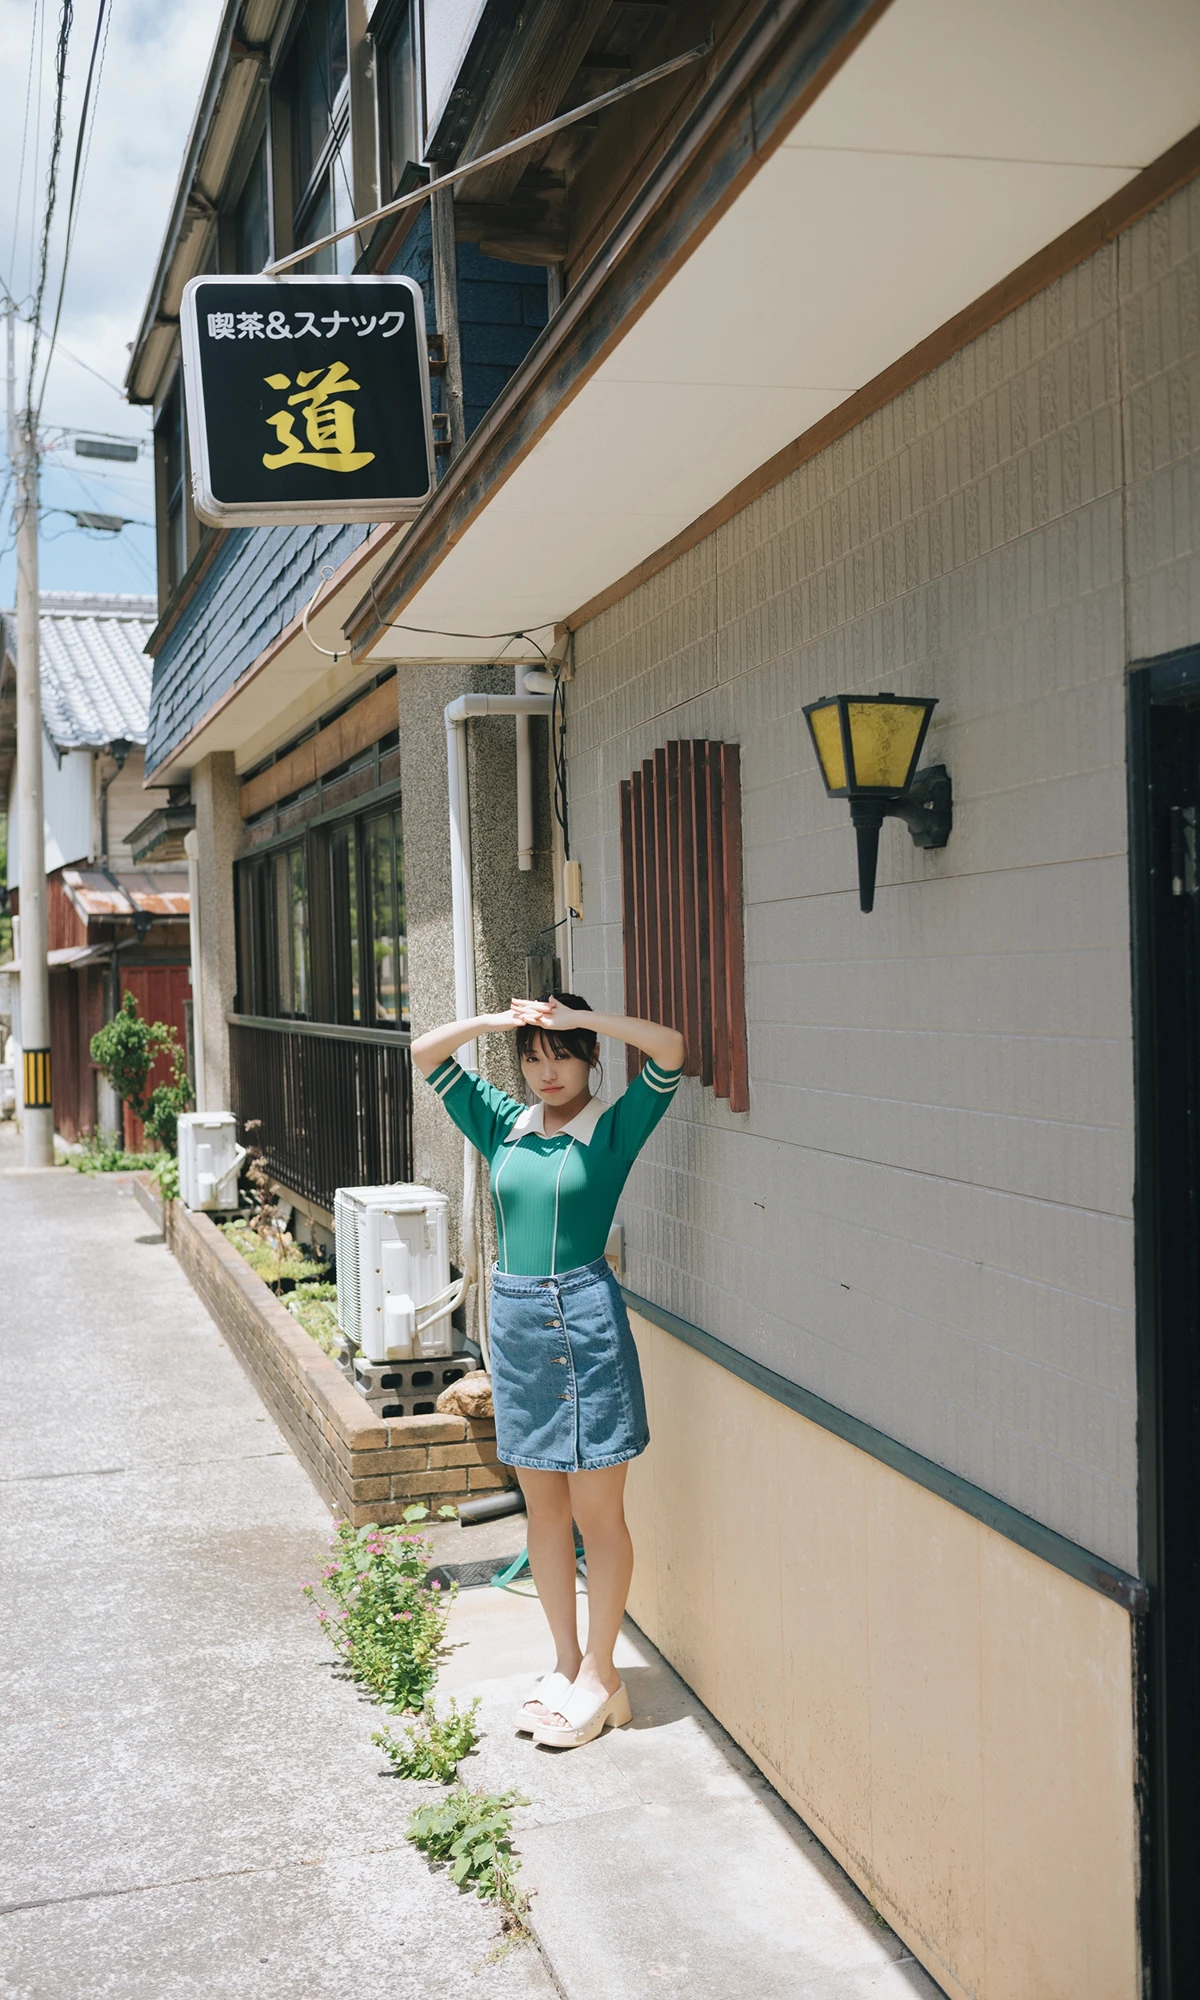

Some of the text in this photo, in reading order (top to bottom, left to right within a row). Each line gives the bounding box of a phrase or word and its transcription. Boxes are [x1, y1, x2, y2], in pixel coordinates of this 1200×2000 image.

[207, 310, 405, 340] 喫茶&スナック
[262, 361, 376, 473] 道
